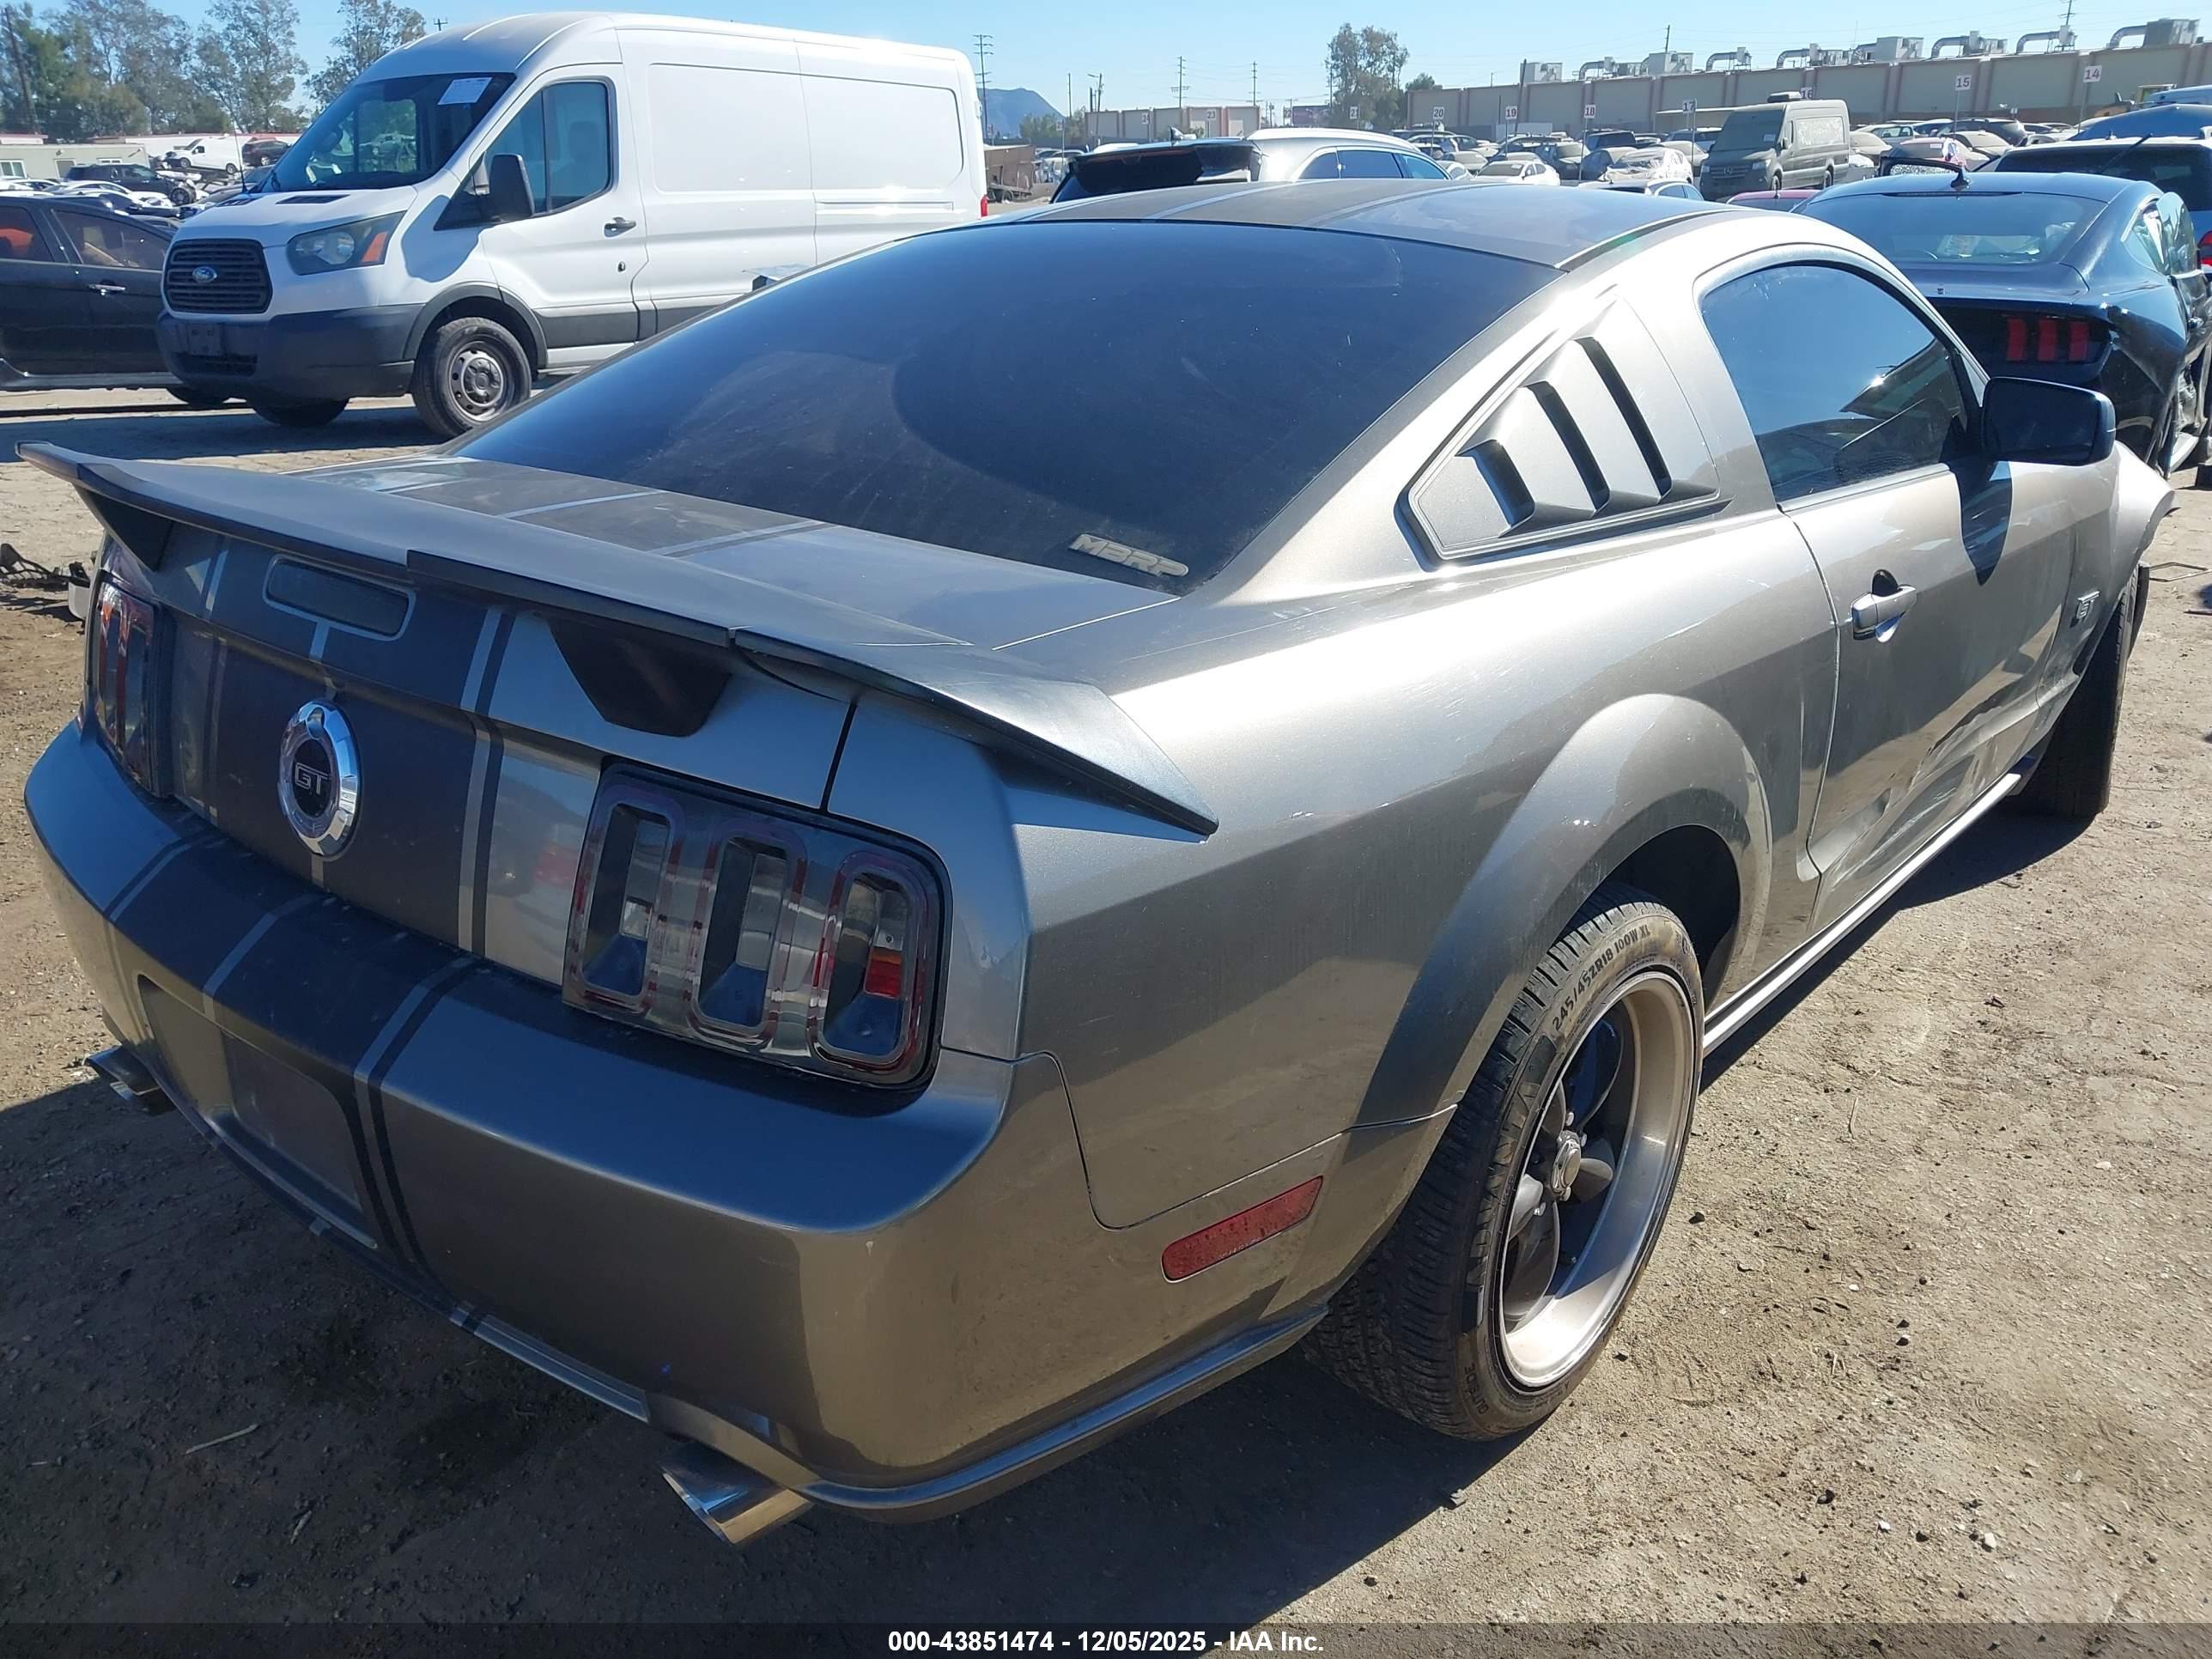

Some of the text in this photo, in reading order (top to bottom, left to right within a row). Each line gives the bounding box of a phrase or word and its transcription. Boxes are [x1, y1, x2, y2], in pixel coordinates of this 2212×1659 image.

[2085, 68, 2100, 80] 14
[1957, 76, 1970, 88] 15
[1433, 107, 1443, 118] 20
[1506, 107, 1517, 118] 19
[1584, 106, 1595, 117] 18
[1682, 101, 1695, 112] 17
[1069, 533, 1189, 577] MBRP
[295, 762, 328, 795] GT
[1552, 947, 1614, 1031] 245/45ZR18
[1613, 927, 1639, 954] 100W
[1639, 924, 1651, 939] XL
